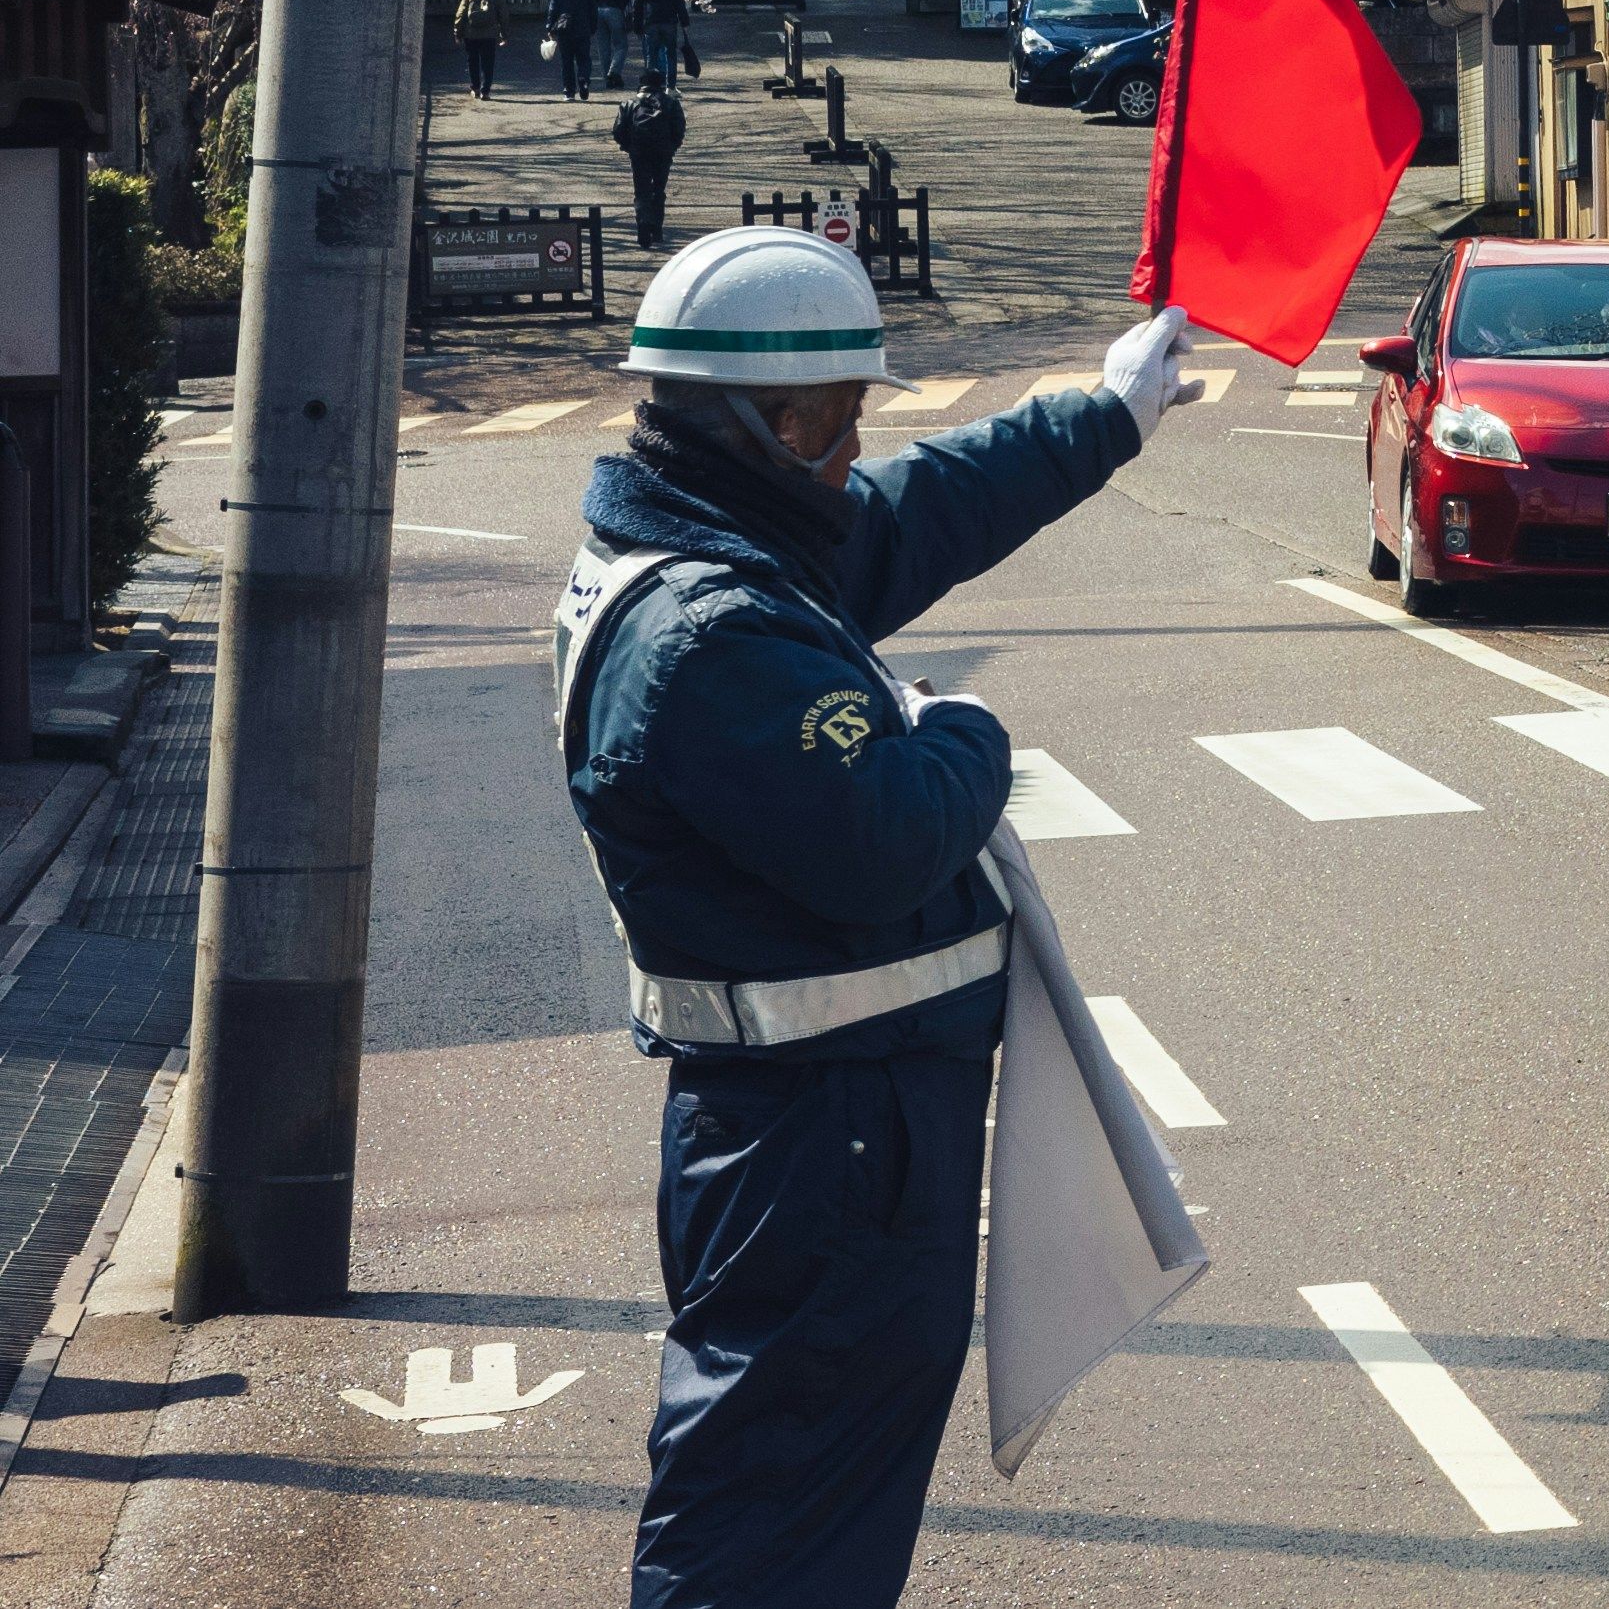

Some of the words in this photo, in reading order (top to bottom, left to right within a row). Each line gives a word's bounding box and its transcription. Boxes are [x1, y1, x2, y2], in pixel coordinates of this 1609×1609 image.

[801, 707, 823, 751] EARTH
[816, 690, 871, 709] SERVICE
[820, 703, 871, 749] ES
